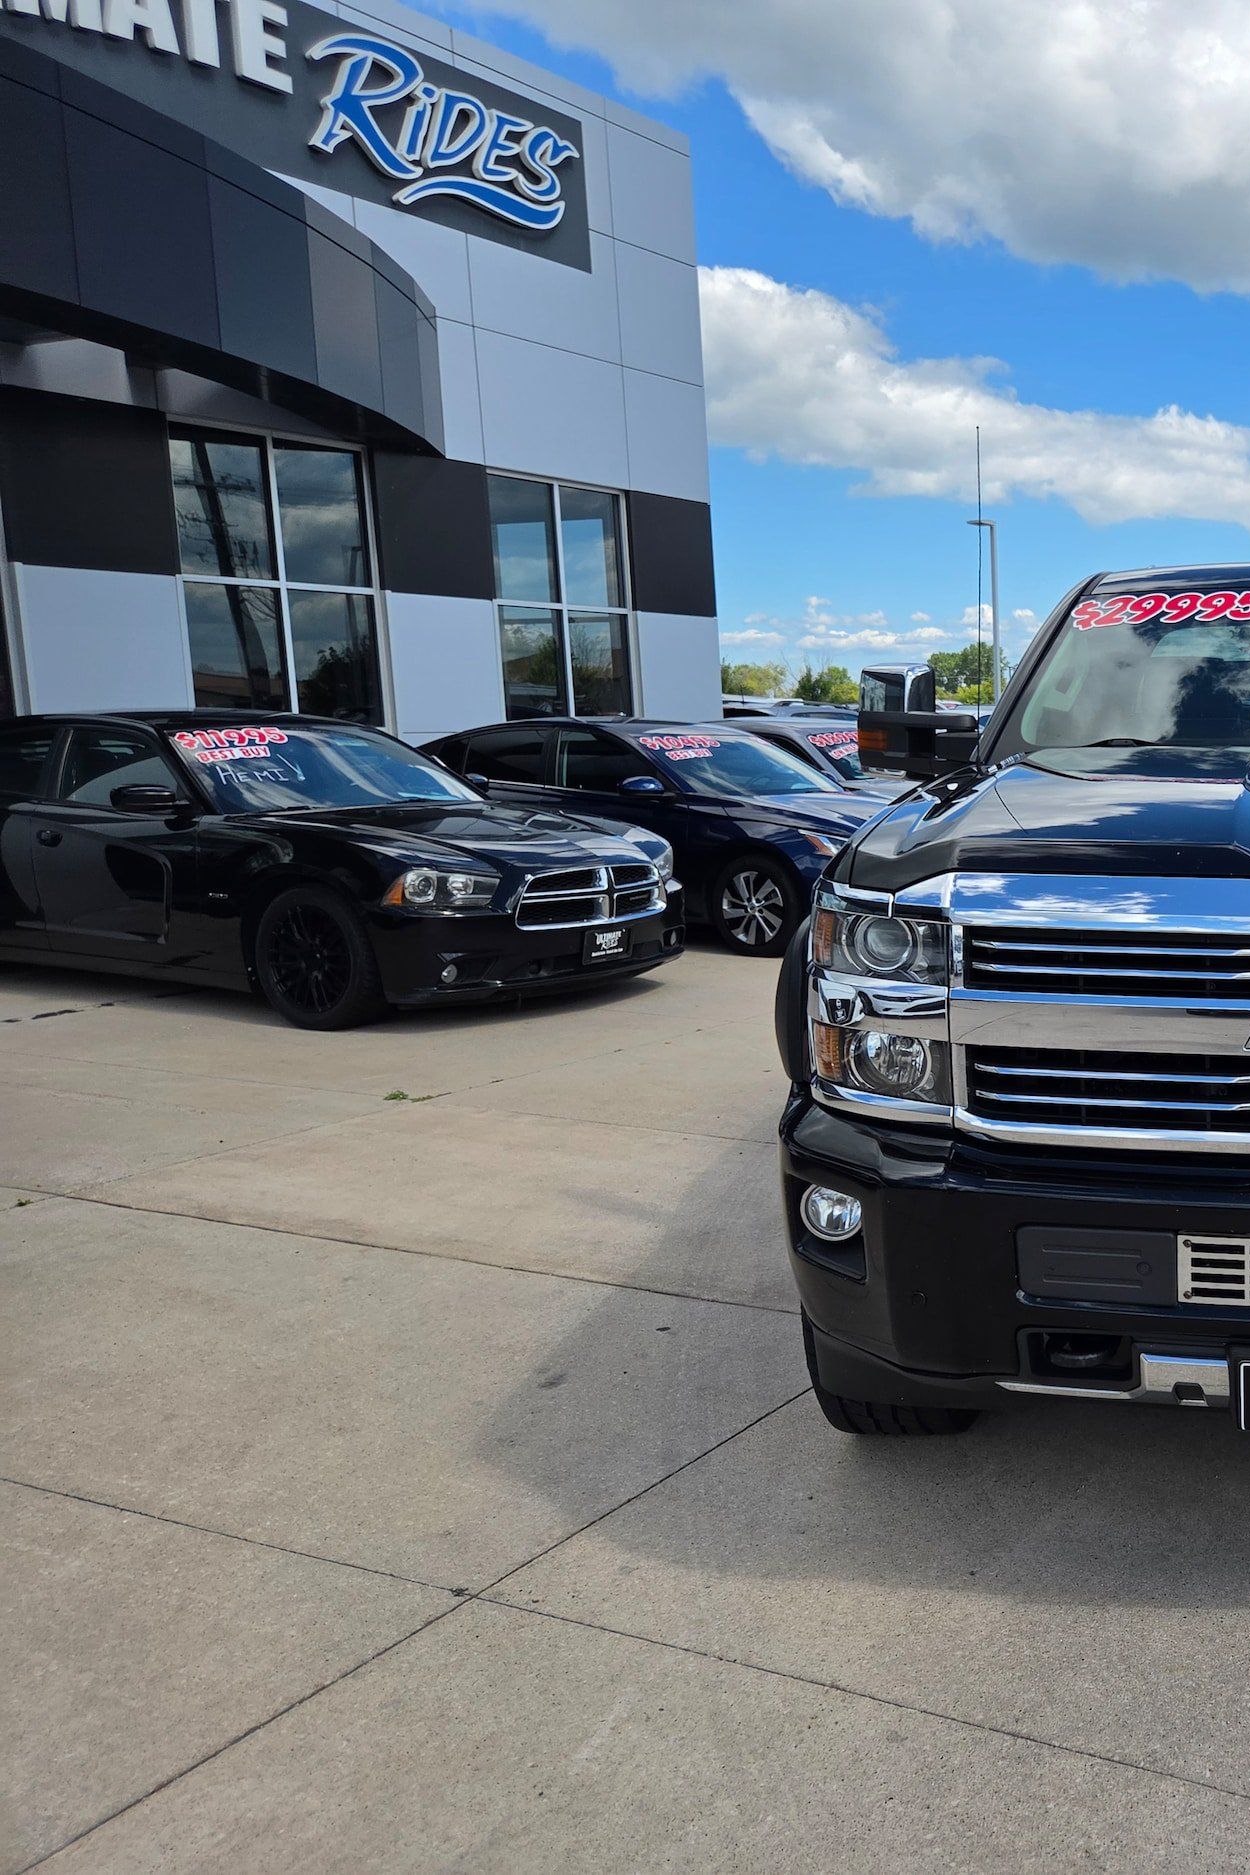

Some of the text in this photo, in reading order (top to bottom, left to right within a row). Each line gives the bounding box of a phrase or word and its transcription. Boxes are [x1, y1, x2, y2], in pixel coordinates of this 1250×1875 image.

[175, 727, 288, 749] $11995
[196, 746, 270, 763] BEST BUY
